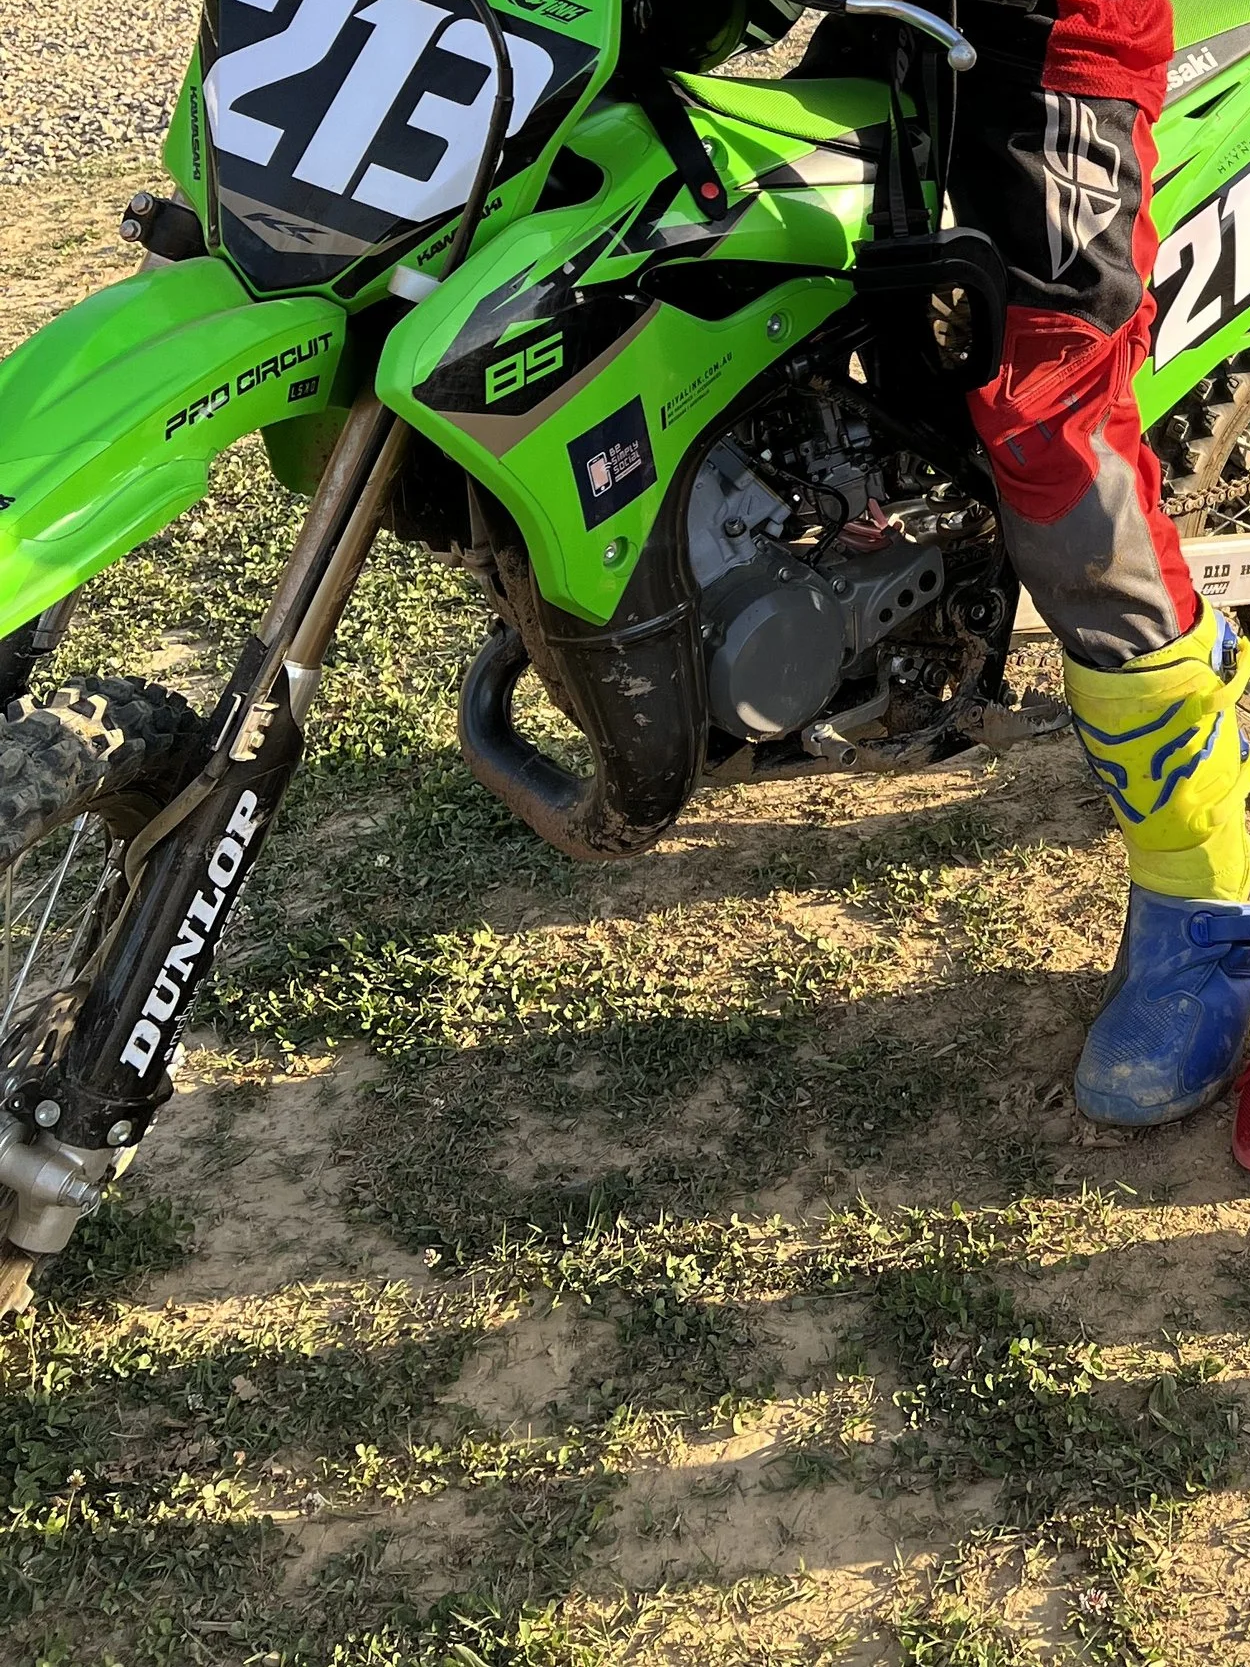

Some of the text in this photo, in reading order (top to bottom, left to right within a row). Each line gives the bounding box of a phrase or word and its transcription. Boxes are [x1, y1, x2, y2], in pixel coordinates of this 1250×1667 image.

[1166, 46, 1219, 92] saki
[190, 85, 201, 181] KAWASAKI
[164, 331, 334, 442] PRO CIRCUIT
[485, 330, 564, 405] 85
[119, 788, 258, 1079] DUNLOP
